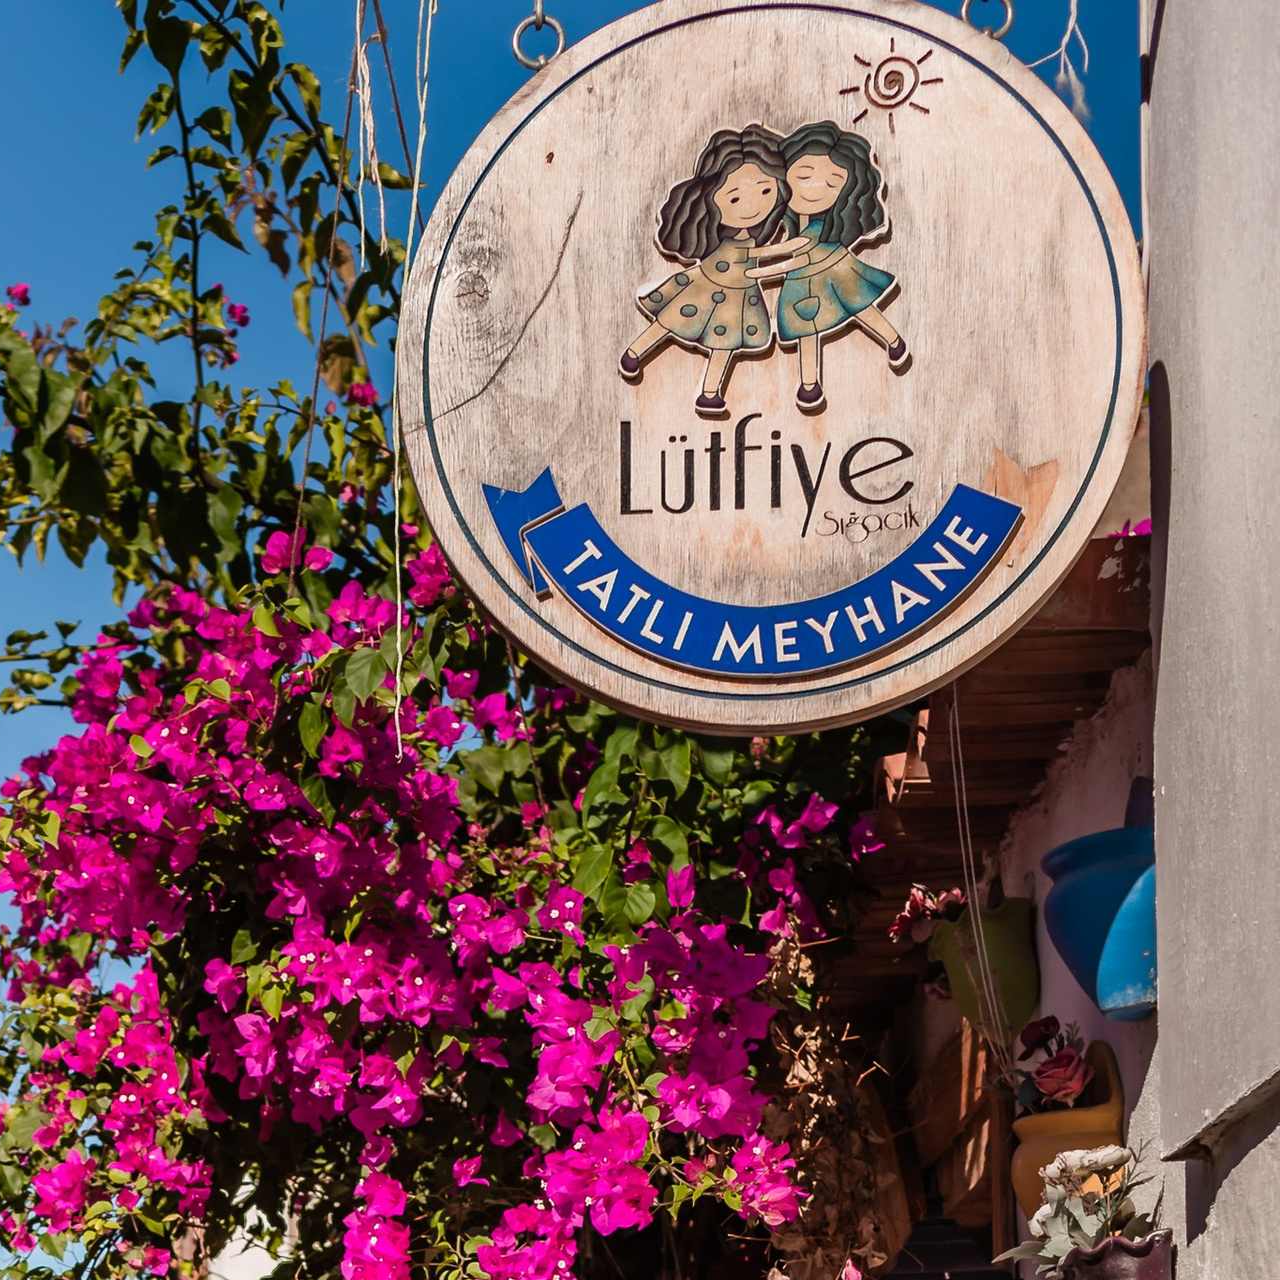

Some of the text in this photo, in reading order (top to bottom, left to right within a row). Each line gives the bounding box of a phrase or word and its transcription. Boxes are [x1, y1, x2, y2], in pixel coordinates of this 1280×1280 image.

[619, 412, 915, 538] Lütfiye
[562, 514, 990, 665] TATLI MEYHANE
